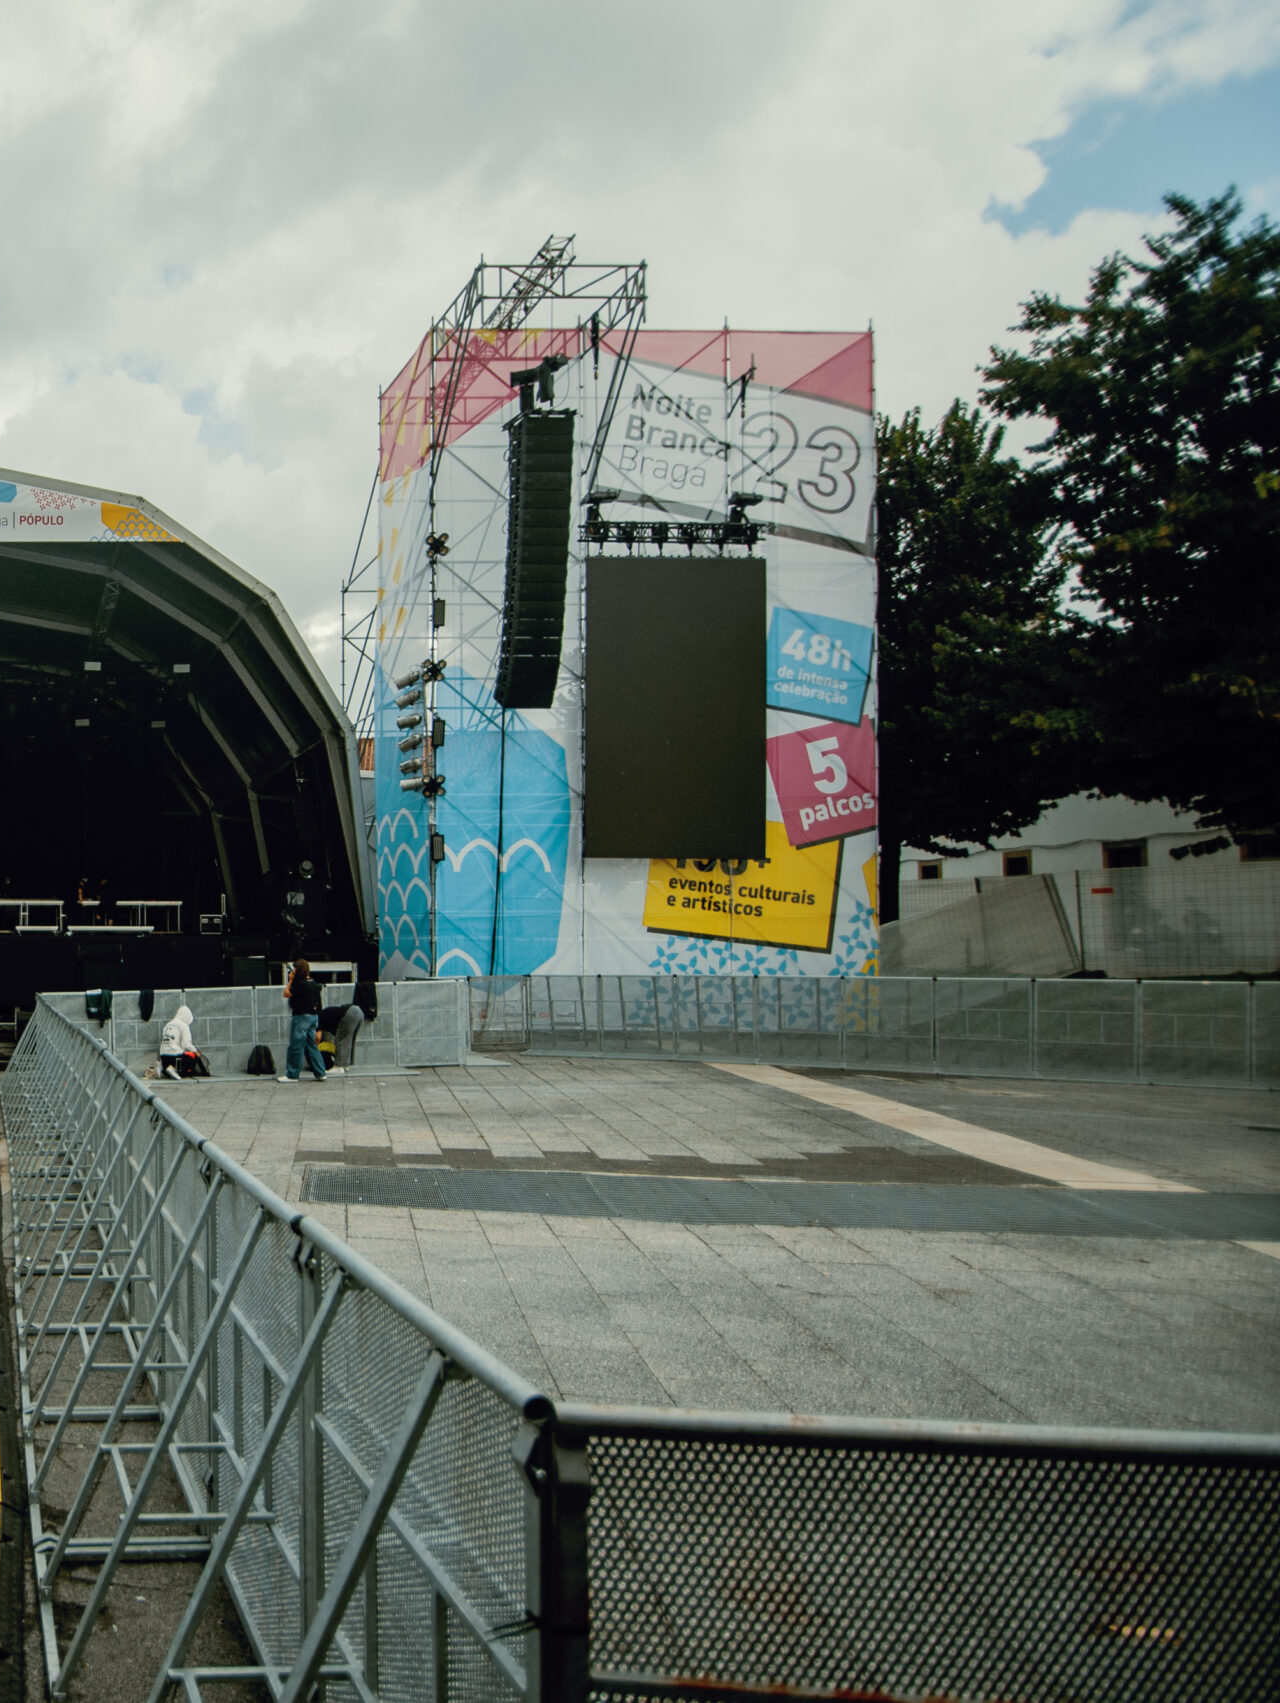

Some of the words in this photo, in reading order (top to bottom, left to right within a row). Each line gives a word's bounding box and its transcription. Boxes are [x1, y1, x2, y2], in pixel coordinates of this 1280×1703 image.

[631, 382, 712, 424] Noite
[625, 414, 730, 463] Branca
[619, 444, 707, 490] Braga
[731, 411, 861, 515] 23
[19, 513, 64, 526] PÓPULO
[781, 628, 852, 672] 48h
[773, 681, 848, 705] celebração
[777, 665, 794, 680] de
[797, 668, 848, 691] intensa
[805, 736, 849, 795] 5
[799, 791, 875, 831] palcos
[666, 894, 677, 906] e
[681, 896, 763, 917] artísticos
[668, 877, 732, 896] eventos
[738, 884, 816, 906] culturais
